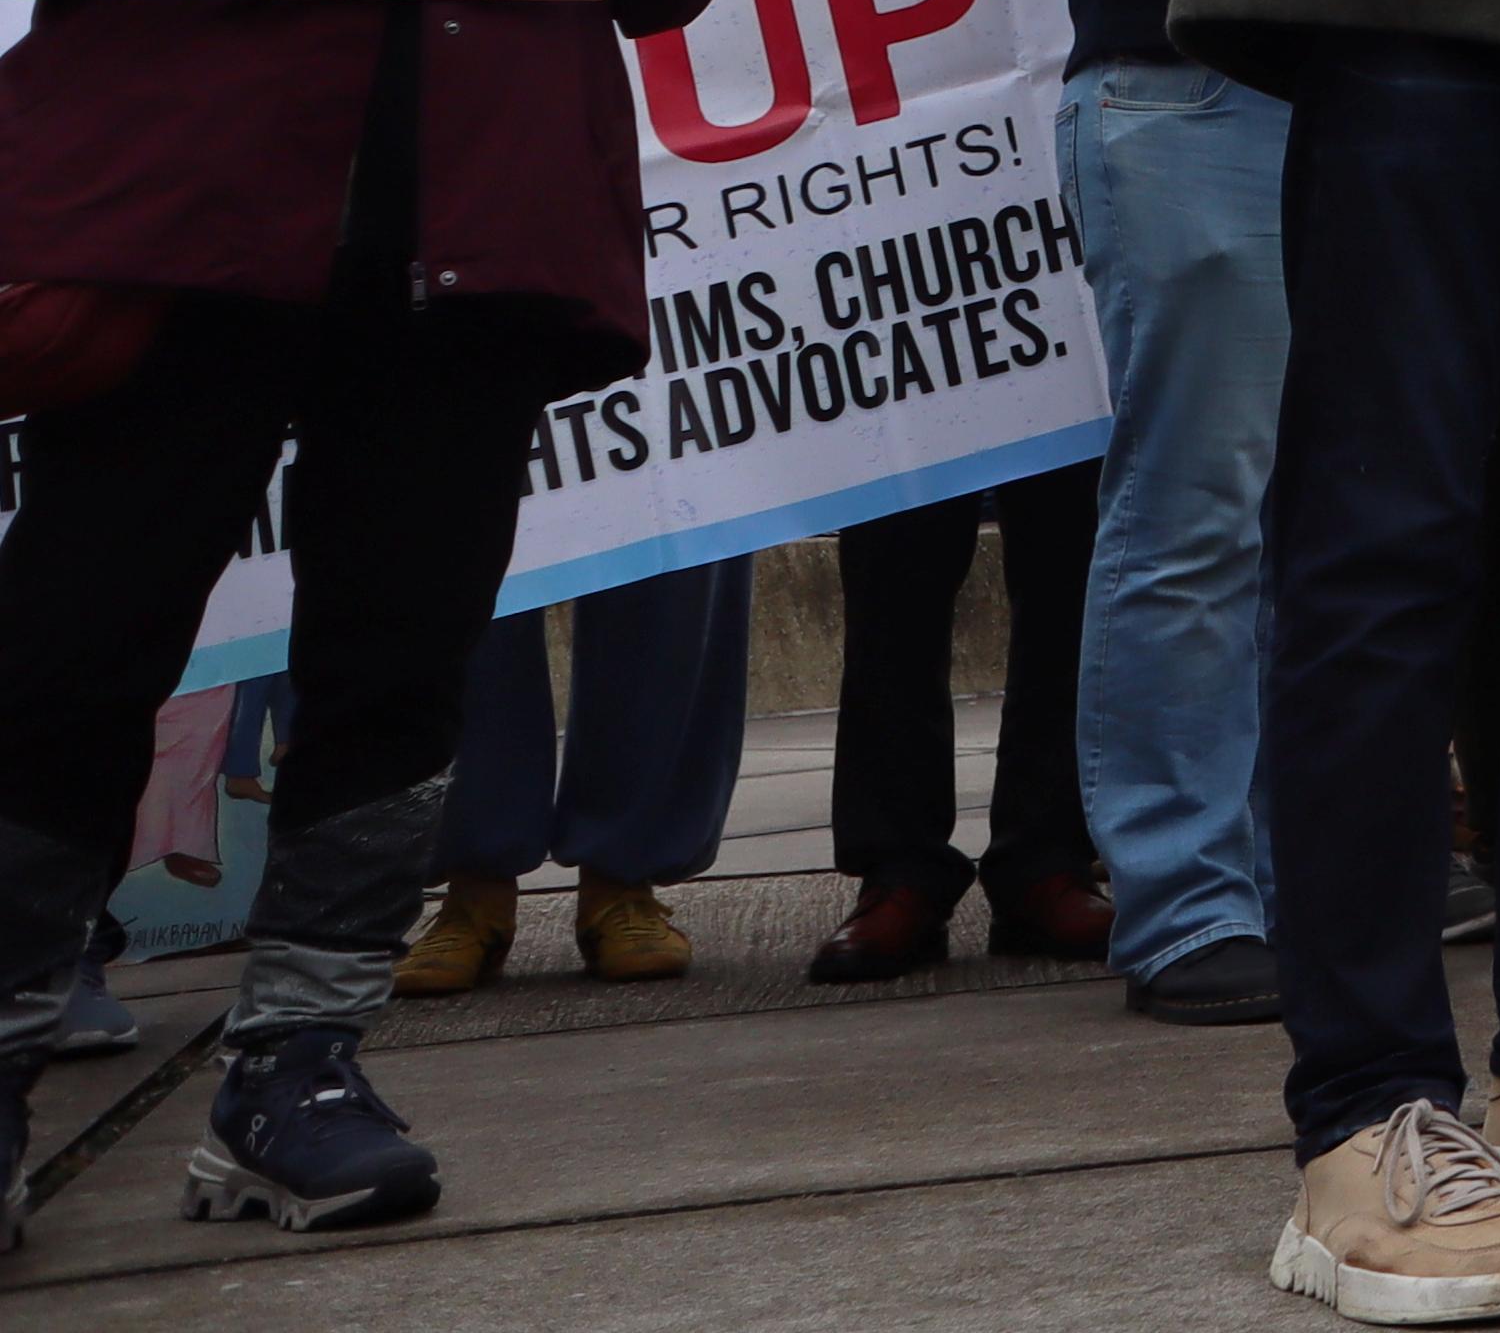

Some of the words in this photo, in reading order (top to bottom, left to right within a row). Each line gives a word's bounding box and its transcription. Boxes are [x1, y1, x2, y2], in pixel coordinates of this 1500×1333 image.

[643, 200, 698, 258] R
[721, 116, 1023, 238] RIGHTS!
[648, 270, 803, 380] IMS,
[814, 193, 1085, 331] CHURCH
[519, 390, 650, 496] HTS
[668, 288, 1068, 460] ADVOCATES.
